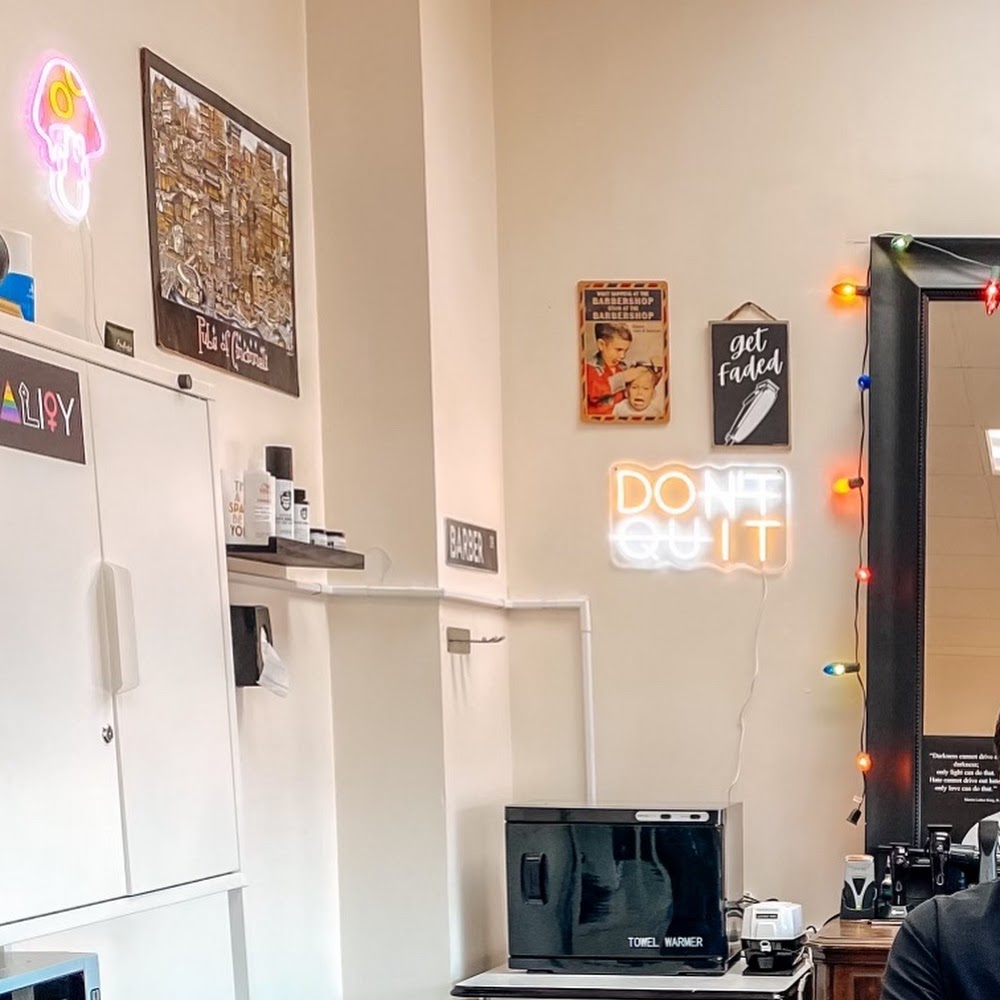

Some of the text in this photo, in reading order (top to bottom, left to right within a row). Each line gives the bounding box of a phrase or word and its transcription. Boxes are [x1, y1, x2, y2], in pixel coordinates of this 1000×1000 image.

[592, 297, 654, 305] BARBERSHOP
[592, 312, 655, 320] BARBERSHOP
[220, 329, 231, 357] of
[730, 327, 769, 360] get
[616, 469, 784, 520] DON'T
[450, 525, 484, 564] BARBER
[614, 516, 782, 562] QUIT
[934, 785, 947, 793] only
[627, 936, 704, 948] TOWEL WARMER
